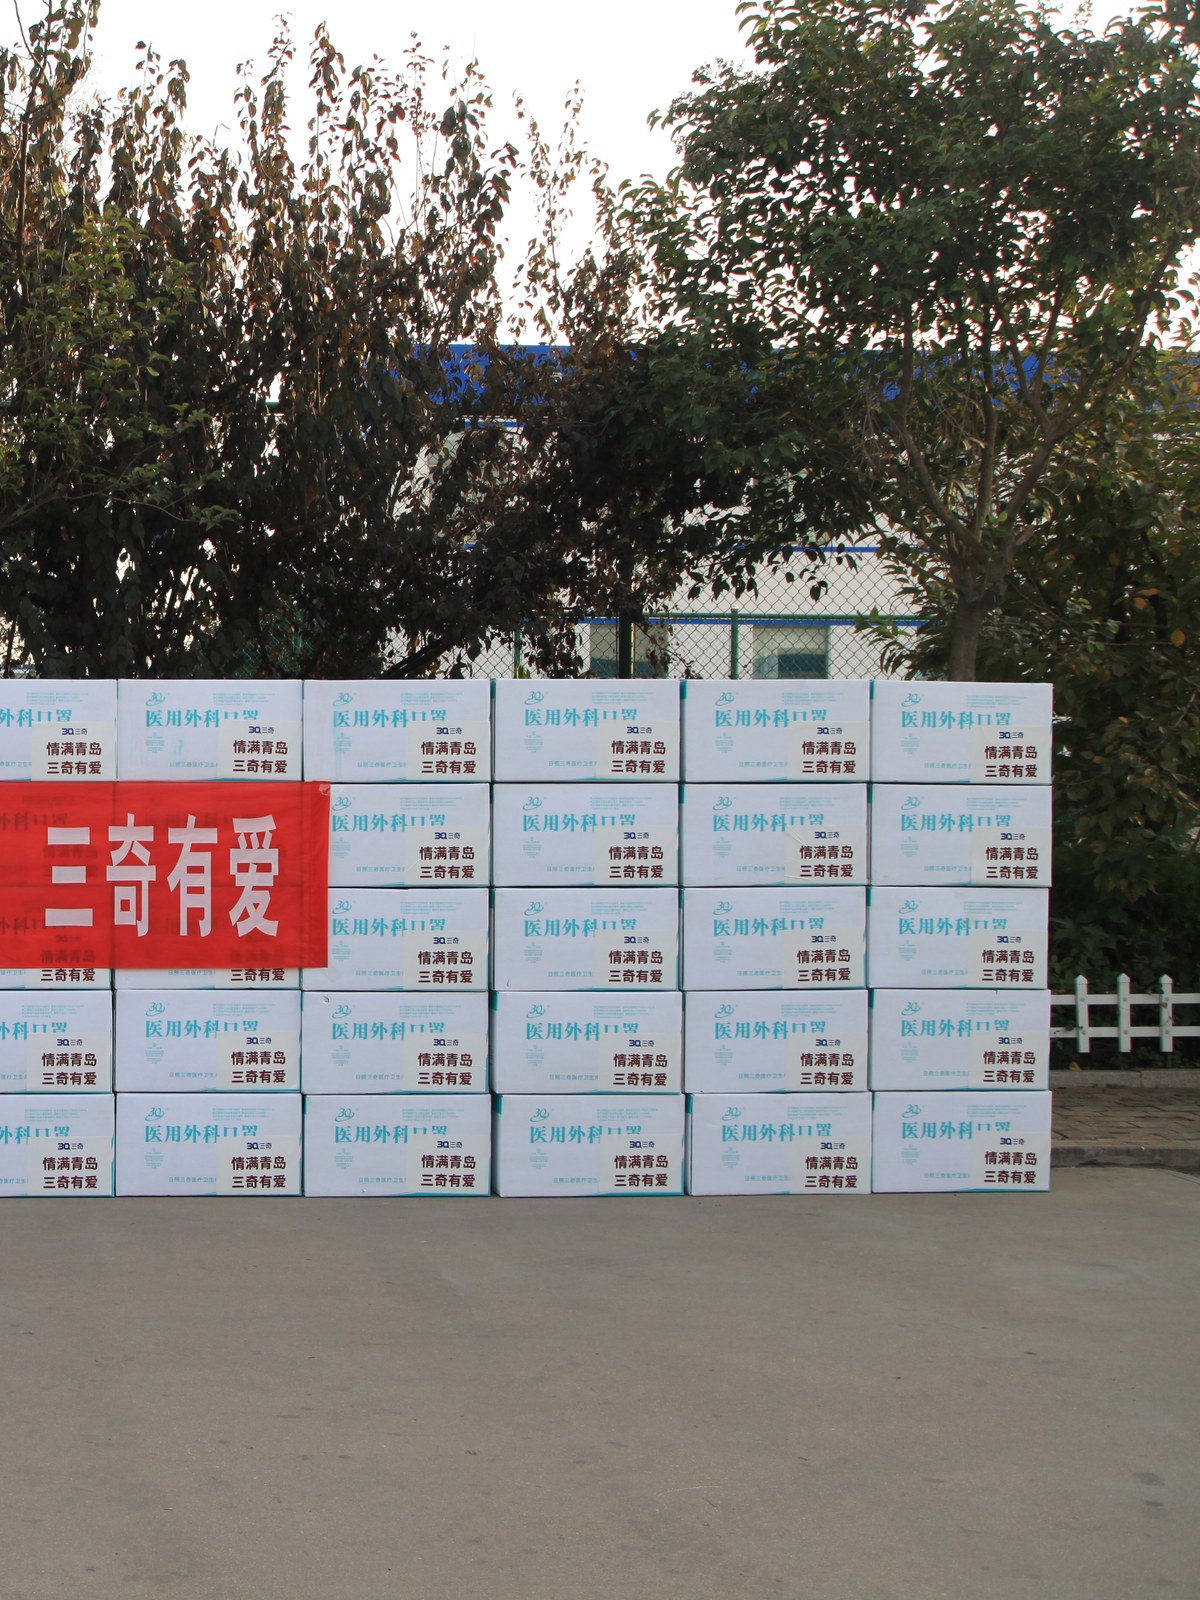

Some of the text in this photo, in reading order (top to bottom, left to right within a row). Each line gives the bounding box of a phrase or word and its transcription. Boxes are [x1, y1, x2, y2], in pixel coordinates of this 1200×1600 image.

[46, 741, 102, 756] 情满青岛
[232, 740, 288, 755] 情满青岛
[420, 741, 477, 756] 情满青岛
[611, 740, 666, 755] 情满青岛
[801, 740, 856, 756] 情满青岛
[984, 745, 1037, 760] 情满青岛
[47, 760, 102, 775] 三奇有爱
[232, 758, 288, 774] 三奇有爱
[421, 759, 477, 774] 三奇有爱
[611, 759, 665, 774] 三奇有爱
[801, 759, 855, 774] 三奇有爱
[982, 763, 1036, 778] 三奇有爱
[419, 846, 474, 861] 情满青岛
[608, 845, 664, 861] 情满青岛
[799, 845, 853, 860] 情满青岛
[985, 846, 1039, 861] 情满青岛
[45, 813, 279, 937] 三奇有爱
[419, 864, 474, 879] 三奇有爱
[608, 864, 664, 879] 三奇有爱
[798, 863, 852, 878] 三奇有爱
[983, 865, 1037, 880] 三奇有爱
[417, 950, 473, 965] 情满青岛
[608, 950, 662, 965] 情满青岛
[796, 948, 850, 964] 情满青岛
[981, 949, 1034, 964] 情满青岛
[40, 968, 96, 982] 三奇有爱
[230, 968, 286, 982] 三奇有爱
[417, 969, 473, 984] 三奇有爱
[608, 968, 662, 983] 三奇有爱
[795, 967, 849, 982] 三奇有爱
[978, 968, 1032, 983] 三奇有爱
[41, 1052, 97, 1067] 情满青岛
[230, 1050, 286, 1066] 情满青岛
[417, 1052, 473, 1067] 情满青岛
[613, 1053, 667, 1068] 情满青岛
[800, 1052, 852, 1067] 情满青岛
[982, 1050, 1035, 1065] 情满青岛
[42, 1071, 96, 1086] 三奇有爱
[231, 1069, 285, 1084] 三奇有爱
[417, 1071, 472, 1086] 三奇有爱
[612, 1071, 667, 1087] 三奇有爱
[798, 1071, 852, 1086] 三奇有爱
[980, 1069, 1034, 1084] 三奇有爱
[42, 1156, 98, 1171] 情满青岛
[231, 1155, 286, 1170] 情满青岛
[420, 1154, 476, 1169] 情满青岛
[613, 1154, 669, 1169] 情满青岛
[805, 1156, 858, 1170] 情满青岛
[984, 1151, 1035, 1166] 情满青岛
[43, 1175, 98, 1189] 三奇有爱
[231, 1174, 285, 1189] 三奇有爱
[420, 1173, 475, 1188] 三奇有爱
[613, 1173, 667, 1187] 三奇有爱
[802, 1174, 856, 1189] 三奇有爱
[980, 1169, 1034, 1184] 三奇有爱
